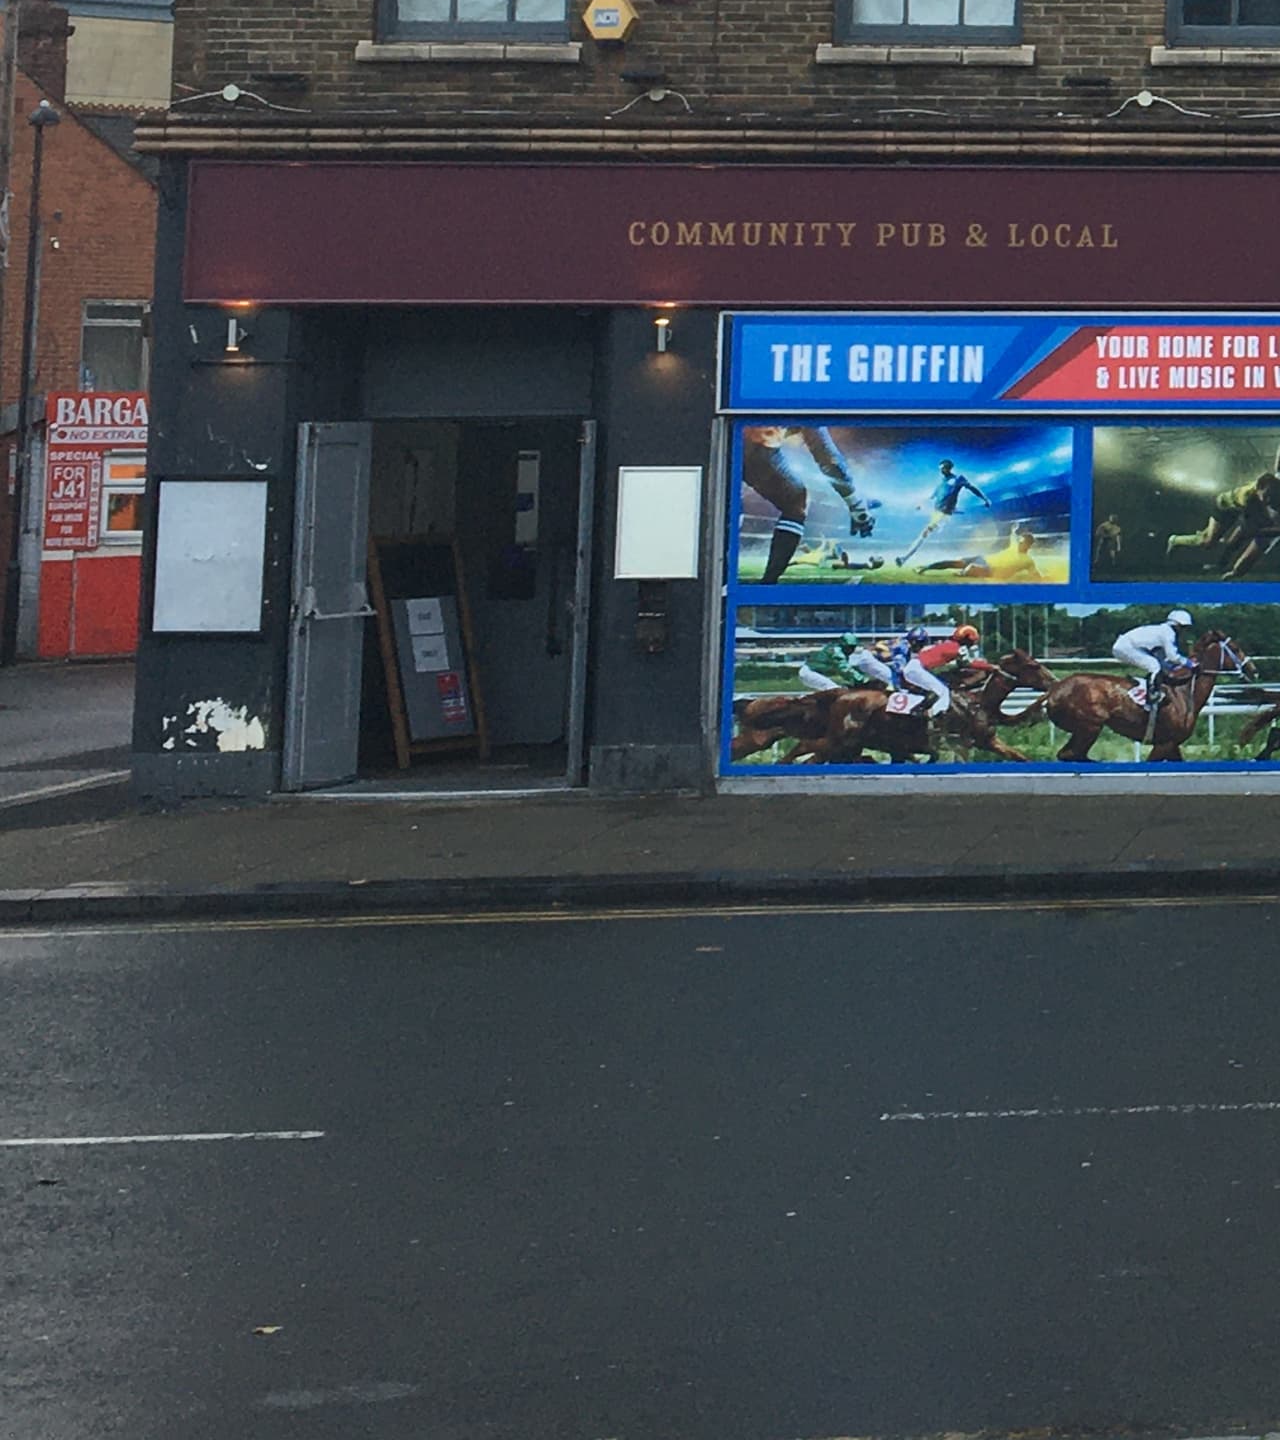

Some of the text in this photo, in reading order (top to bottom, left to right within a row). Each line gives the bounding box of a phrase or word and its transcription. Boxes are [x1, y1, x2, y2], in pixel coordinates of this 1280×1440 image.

[628, 221, 1119, 248] COMMUNITY PUB & LOCAL
[1096, 335, 1150, 358] YOUR
[1157, 335, 1216, 358] HOME
[1222, 335, 1260, 359] FOR
[771, 344, 984, 384] THE GRIFFIN
[1096, 366, 1110, 389] &
[1119, 366, 1161, 389] LIVE
[1168, 366, 1236, 389] MUSIC
[1244, 366, 1265, 389] IN
[69, 430, 89, 440] NO
[92, 429, 135, 440] EXTRA
[50, 451, 101, 461] SPECIAL
[53, 466, 85, 480] FOR
[53, 481, 86, 498] J41
